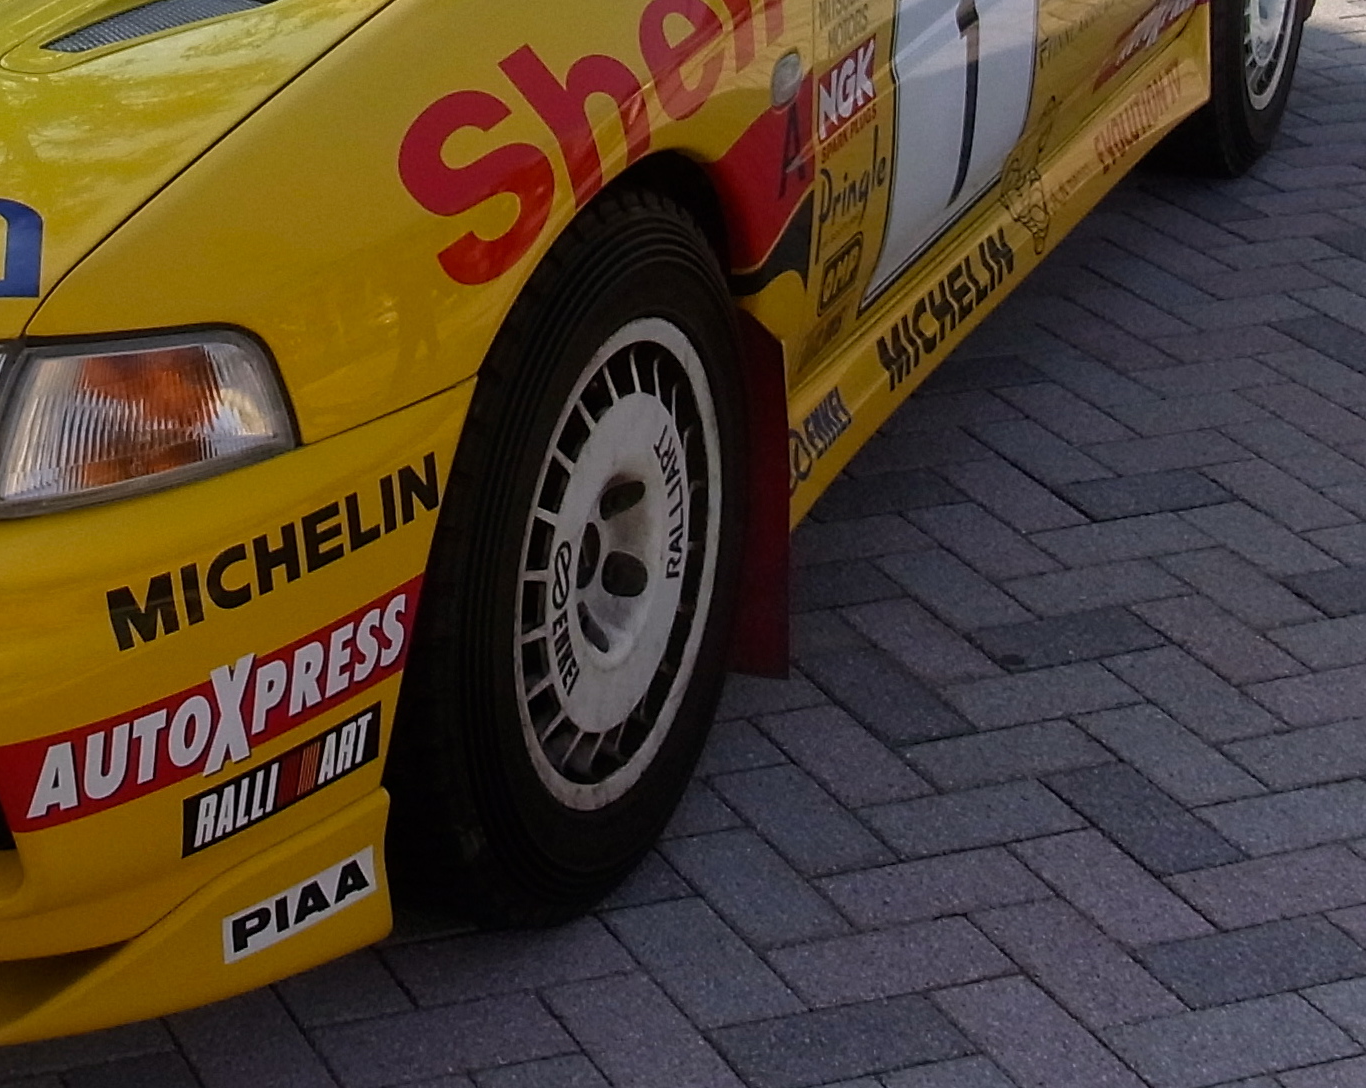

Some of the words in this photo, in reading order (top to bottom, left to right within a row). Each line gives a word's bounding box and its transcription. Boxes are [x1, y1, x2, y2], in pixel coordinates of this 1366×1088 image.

[819, 39, 875, 139] NGK
[828, 3, 868, 58] MOTORS
[815, 124, 887, 265] Pringle
[877, 227, 1015, 392] MICHELIN
[106, 452, 440, 651] MICHELIN
[653, 425, 684, 580] RALLIART
[27, 594, 407, 819] AUTOXPRESS
[231, 860, 370, 954] PIAA
